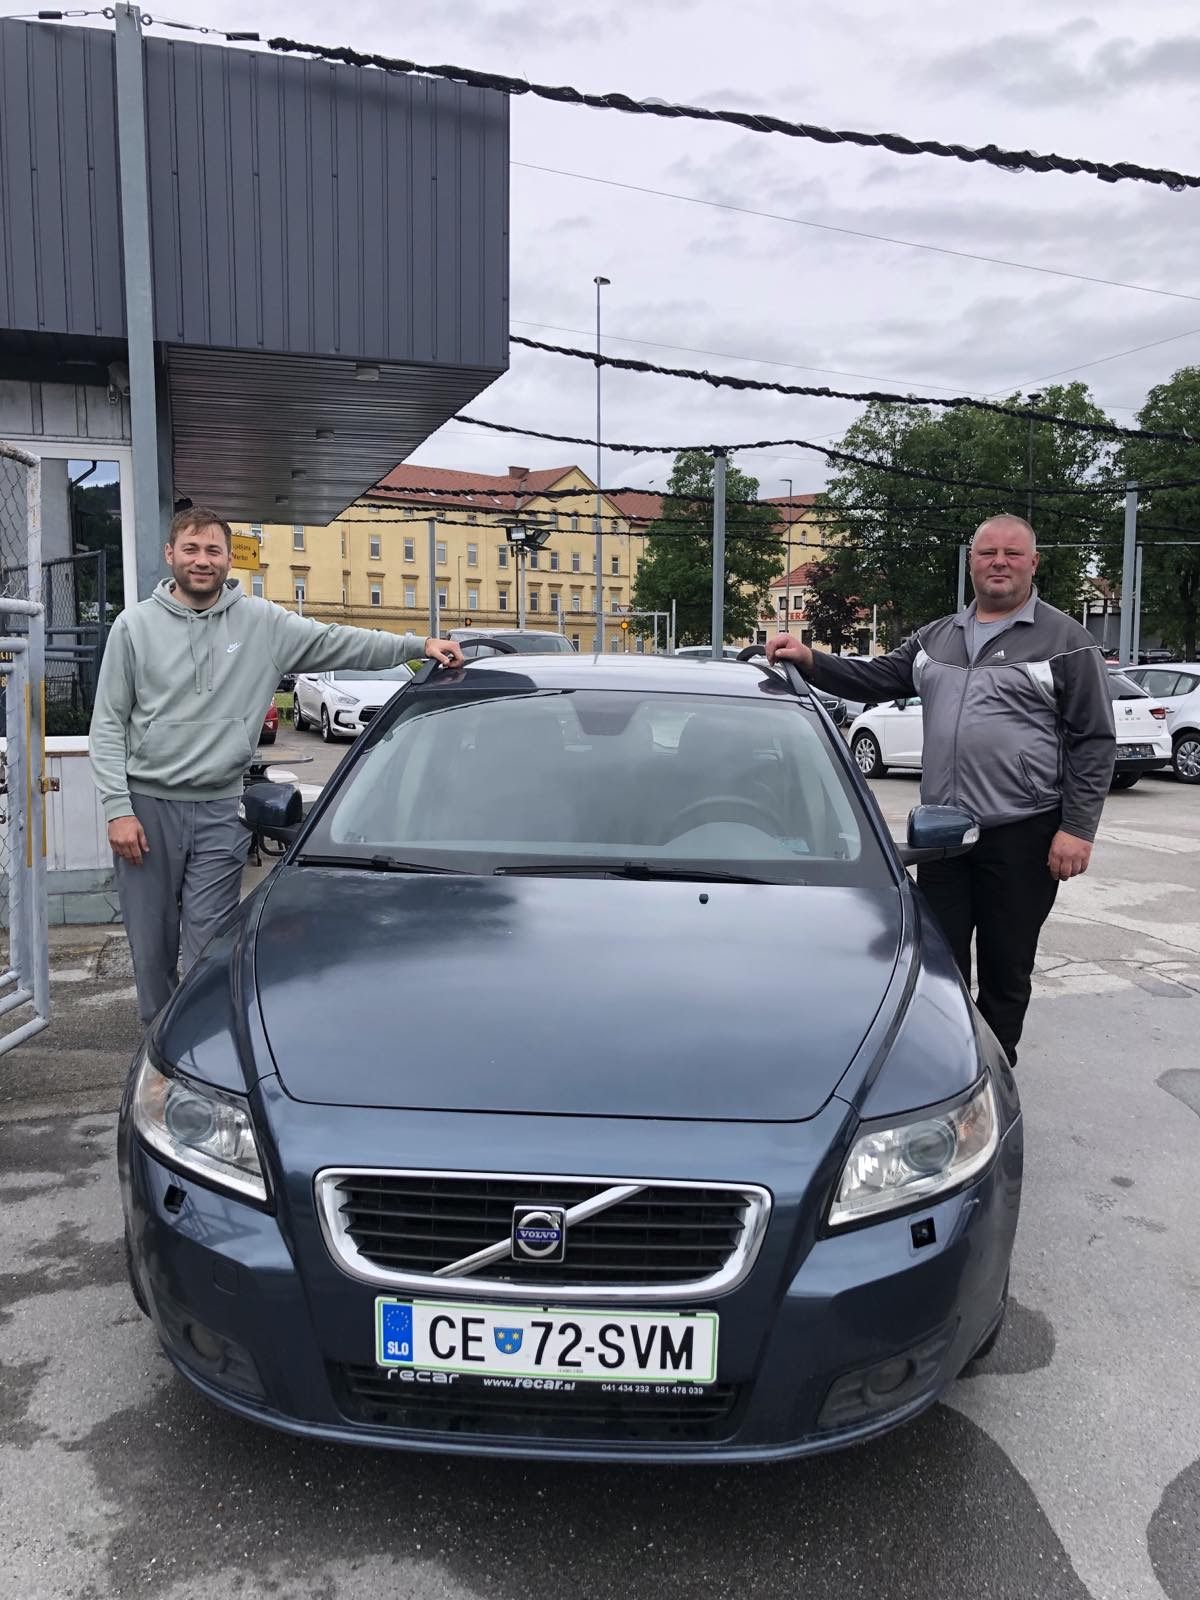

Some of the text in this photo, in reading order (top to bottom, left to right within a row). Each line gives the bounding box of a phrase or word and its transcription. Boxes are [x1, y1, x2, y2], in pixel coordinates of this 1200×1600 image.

[520, 1230, 557, 1239] VOLVO
[387, 1341, 409, 1356] SLO
[429, 1314, 694, 1370] CE 72-SVM
[387, 1368, 460, 1384] recar
[601, 1383, 616, 1391] 041
[618, 1384, 633, 1392] 434
[635, 1385, 650, 1393] 232
[655, 1386, 669, 1394] 051
[688, 1386, 704, 1396] 039
